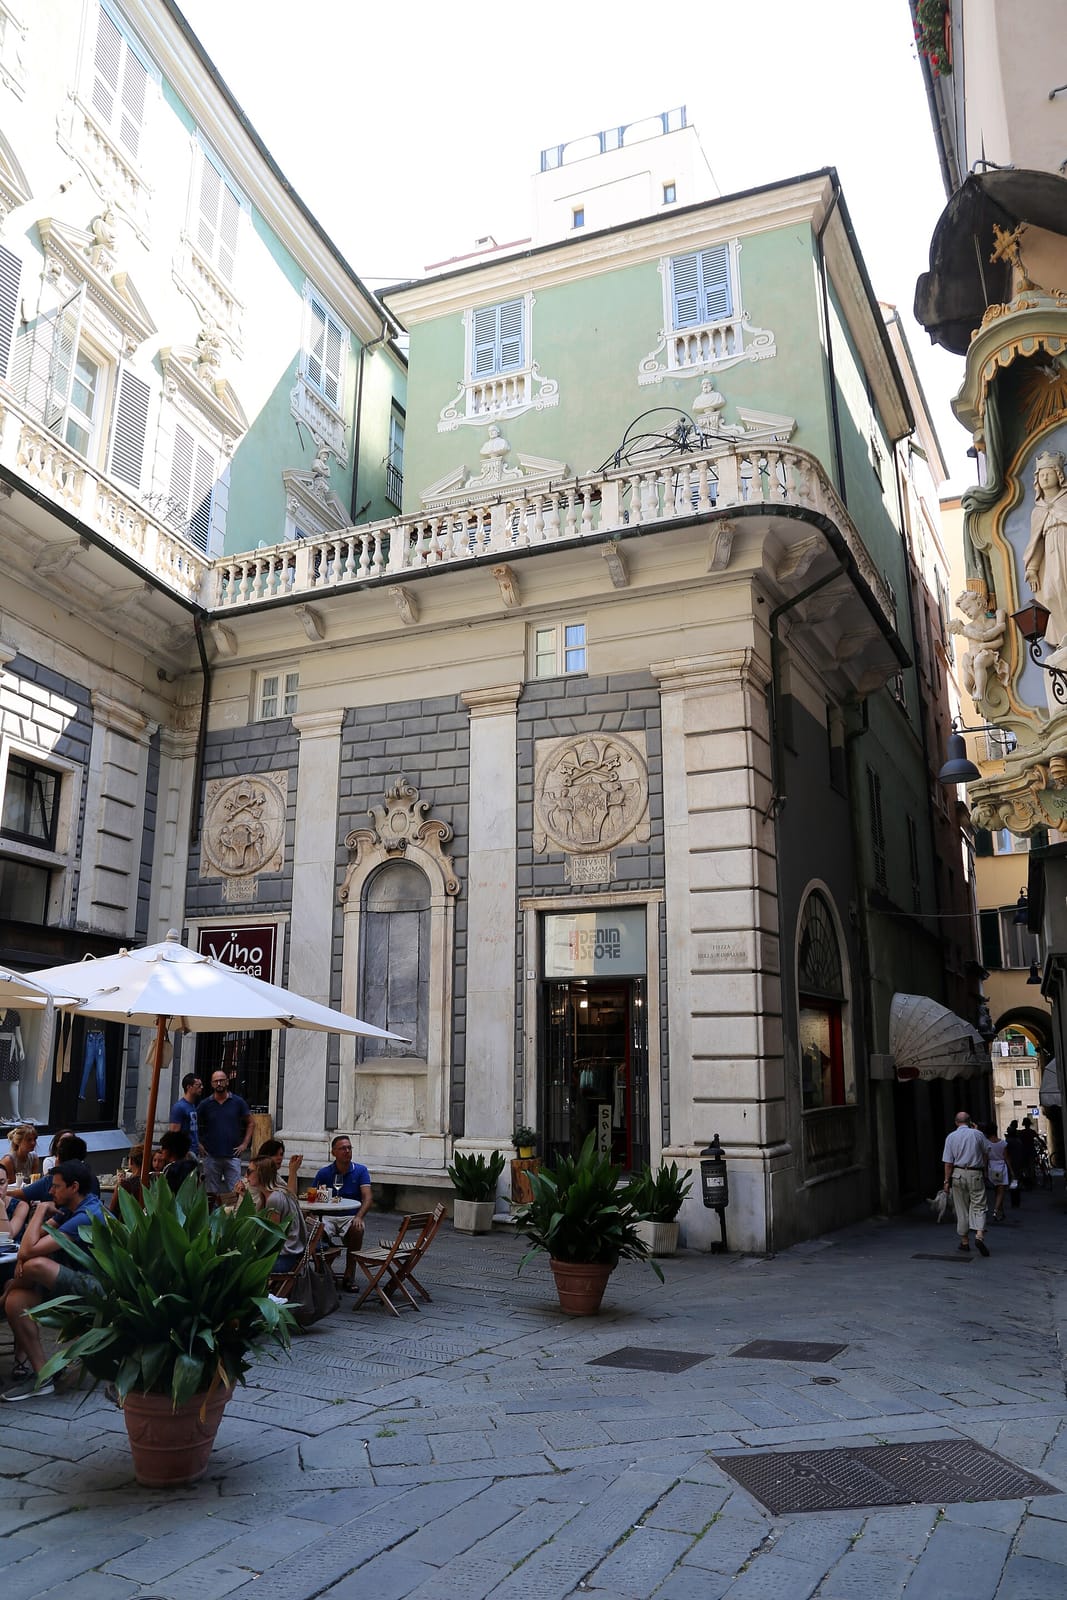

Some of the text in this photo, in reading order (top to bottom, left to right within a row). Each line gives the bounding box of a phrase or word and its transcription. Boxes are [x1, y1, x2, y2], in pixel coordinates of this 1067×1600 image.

[580, 928, 620, 944] DENIM
[209, 933, 263, 963] Vino
[580, 944, 620, 960] STORE
